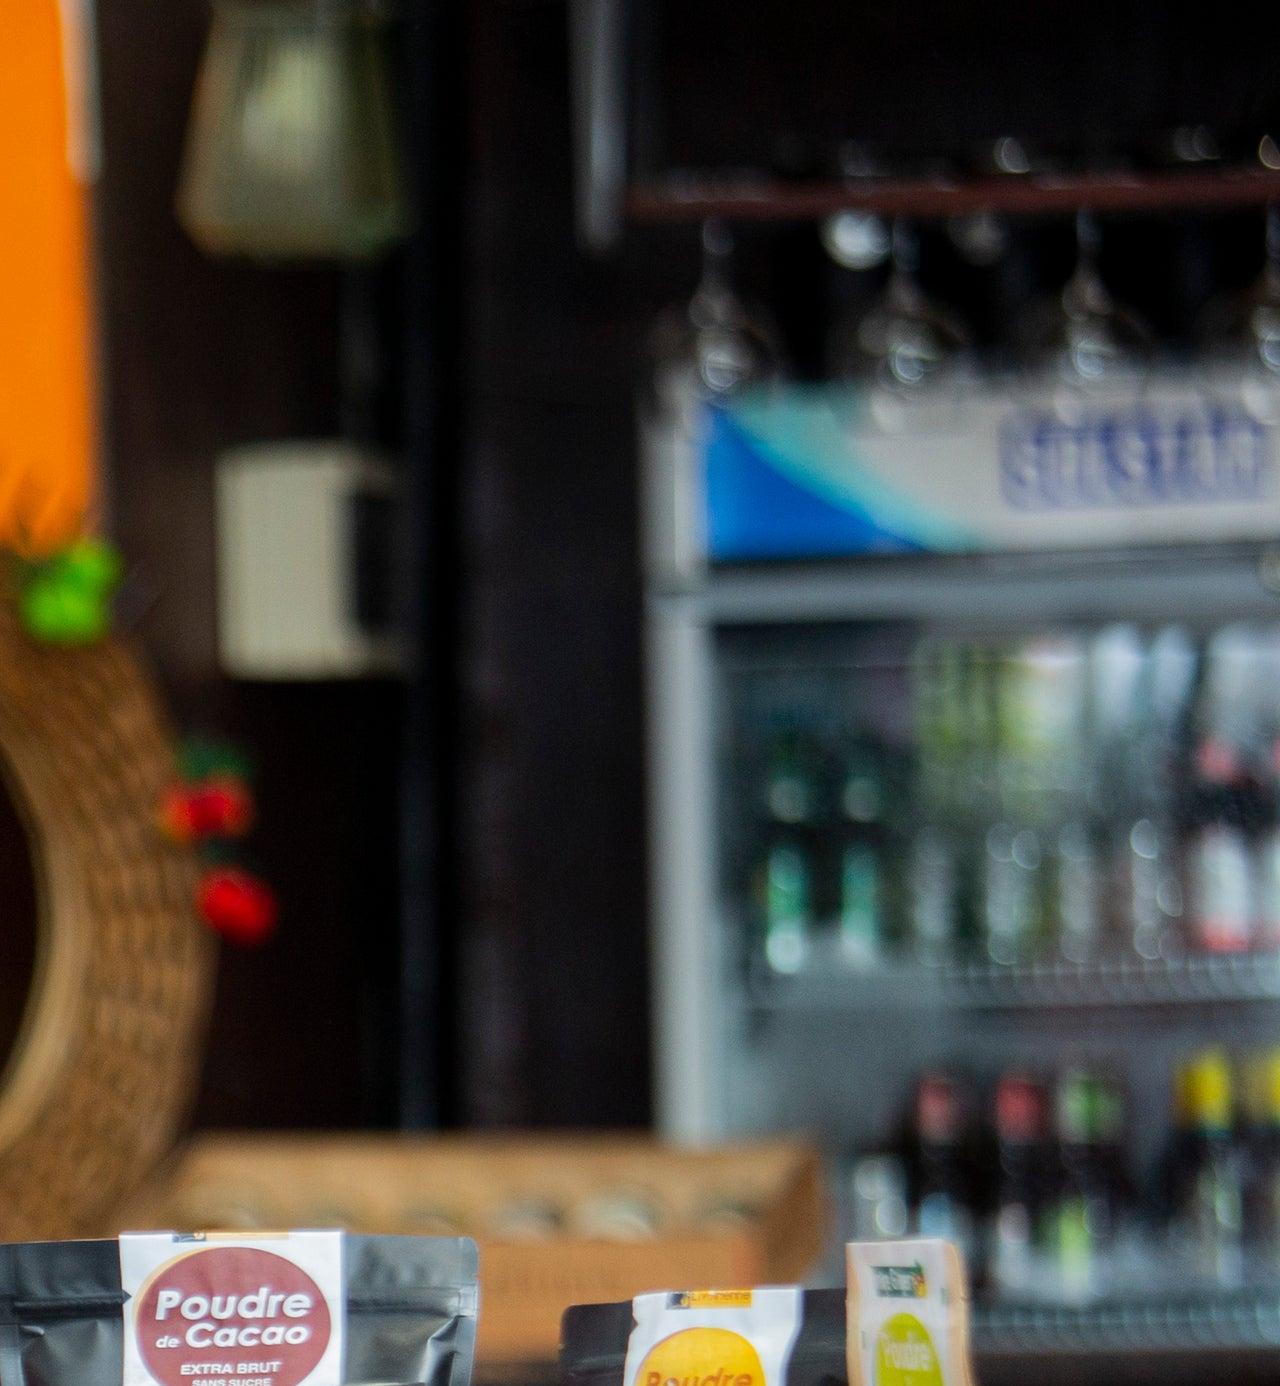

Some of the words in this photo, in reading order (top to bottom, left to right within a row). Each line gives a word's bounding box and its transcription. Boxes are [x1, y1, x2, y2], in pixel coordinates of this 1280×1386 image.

[155, 1287, 312, 1321] Poudre
[155, 1336, 180, 1348] de
[185, 1322, 308, 1348] Cacao
[180, 1363, 234, 1375] EXTRA
[237, 1361, 281, 1373] BRUT
